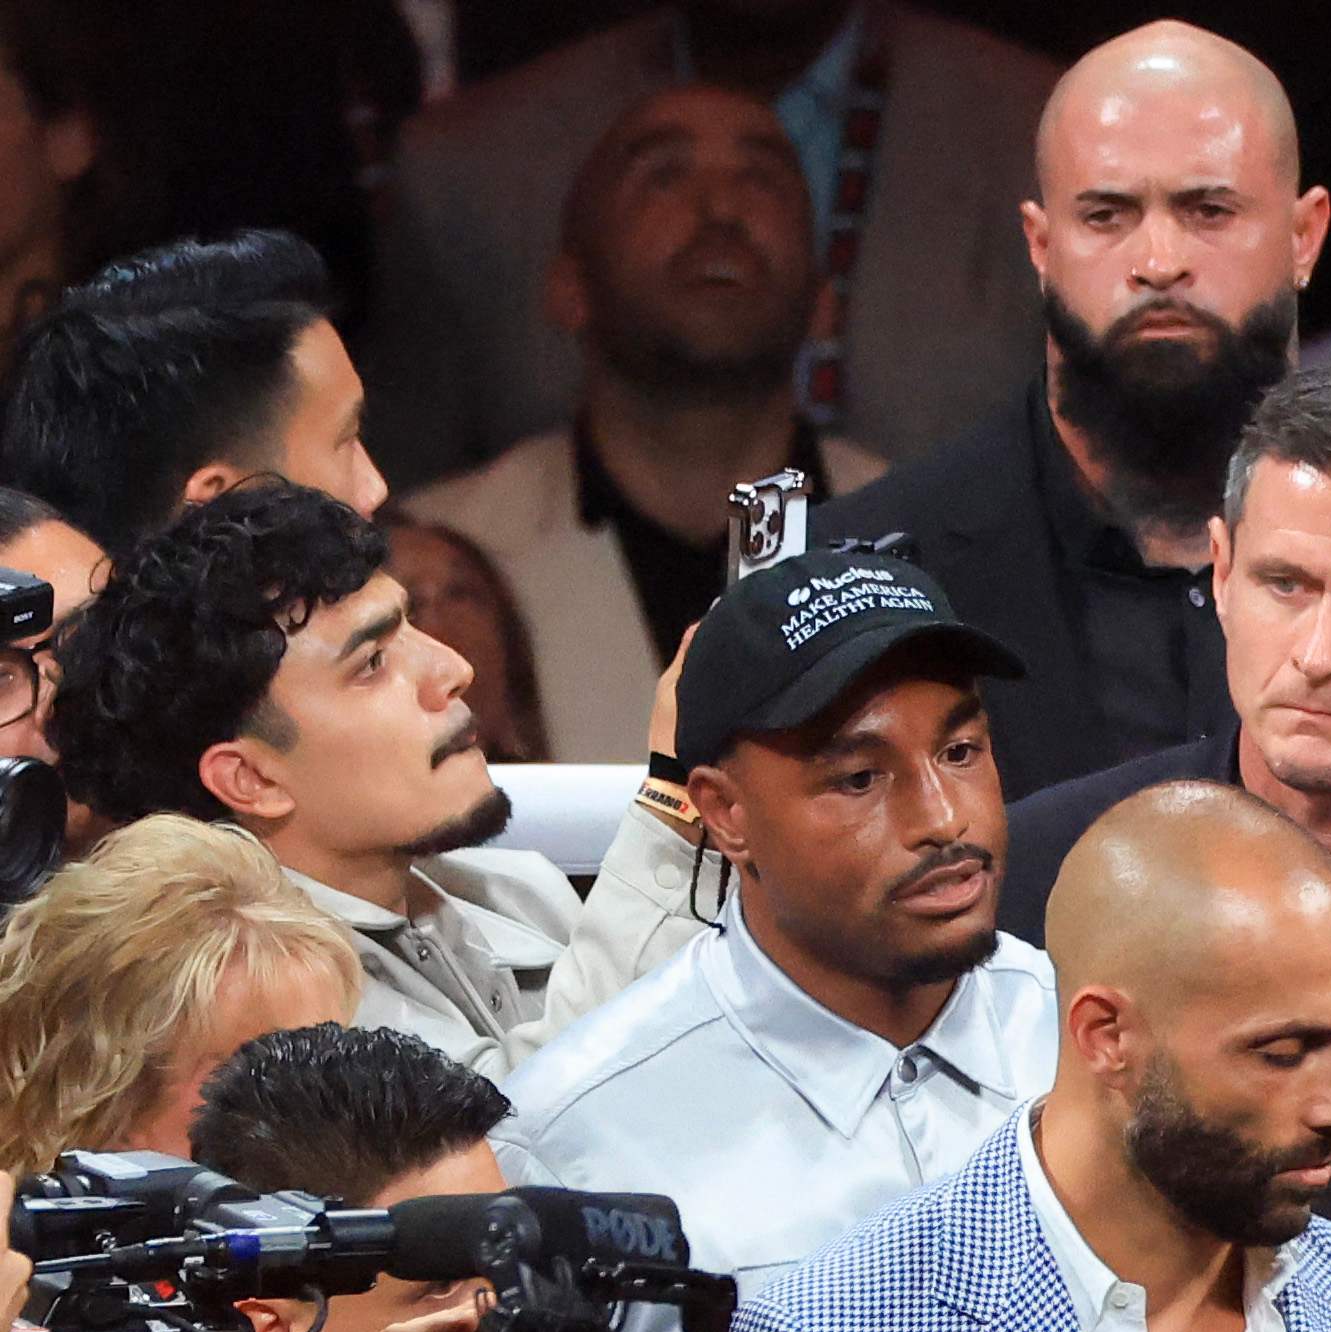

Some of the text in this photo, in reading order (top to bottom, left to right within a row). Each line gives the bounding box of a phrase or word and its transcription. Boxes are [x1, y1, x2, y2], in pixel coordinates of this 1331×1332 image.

[810, 566, 894, 591] Nucleus
[780, 582, 926, 637] MAKE AMERICA
[786, 595, 934, 650] HEALTHY AGAIN
